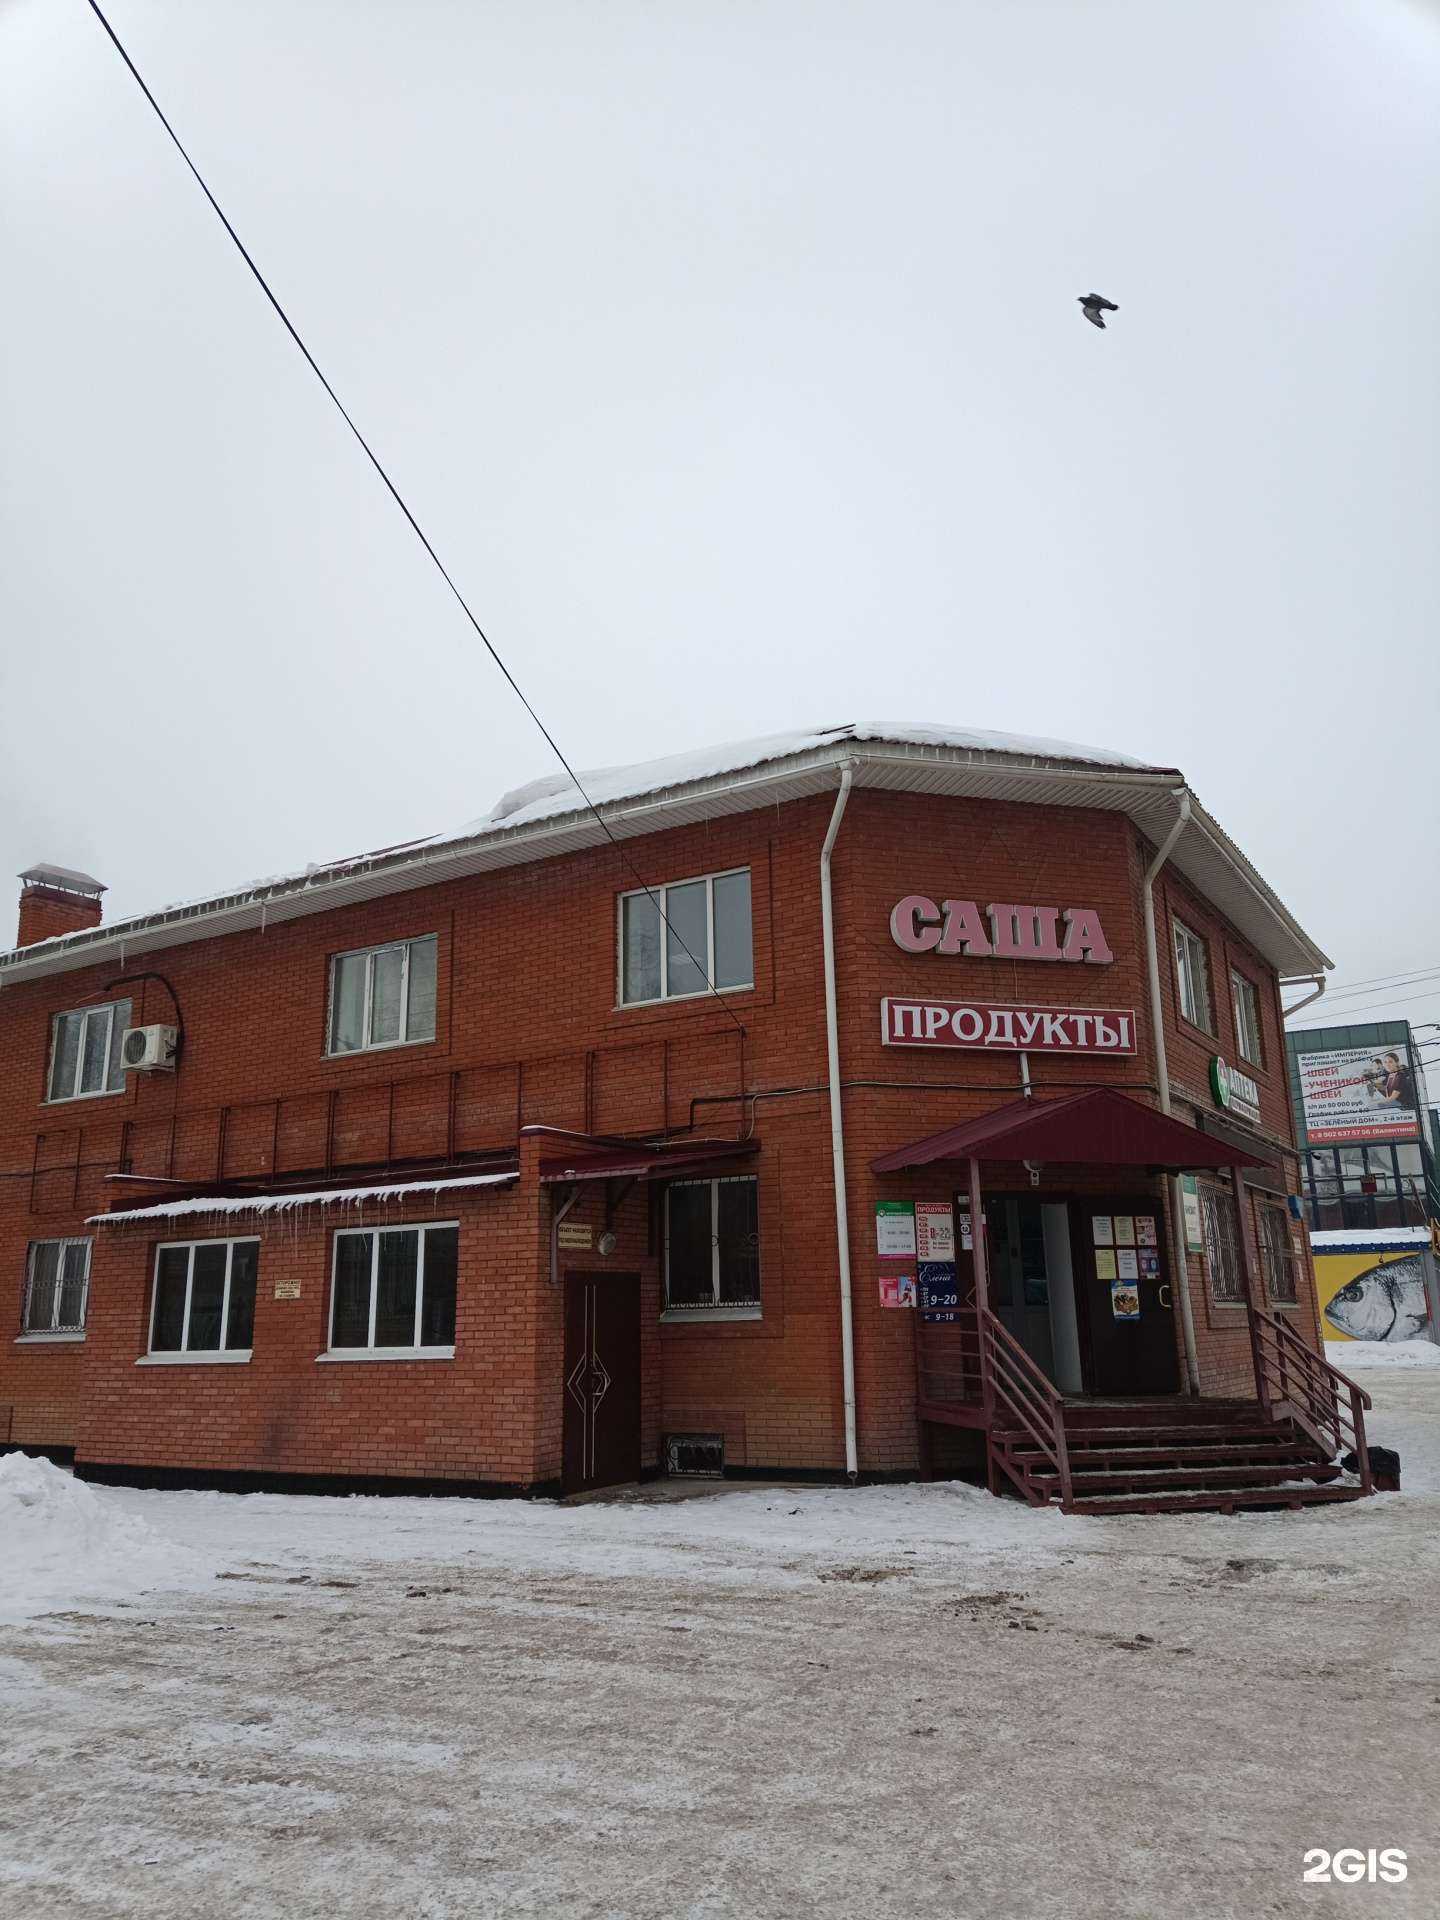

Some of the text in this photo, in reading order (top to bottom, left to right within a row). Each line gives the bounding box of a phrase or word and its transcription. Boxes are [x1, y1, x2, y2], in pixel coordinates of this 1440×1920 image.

[890, 895, 1113, 964] САША
[892, 1005, 1130, 1048] ПРОДУКТЫ
[930, 1294, 957, 1305] 9-20
